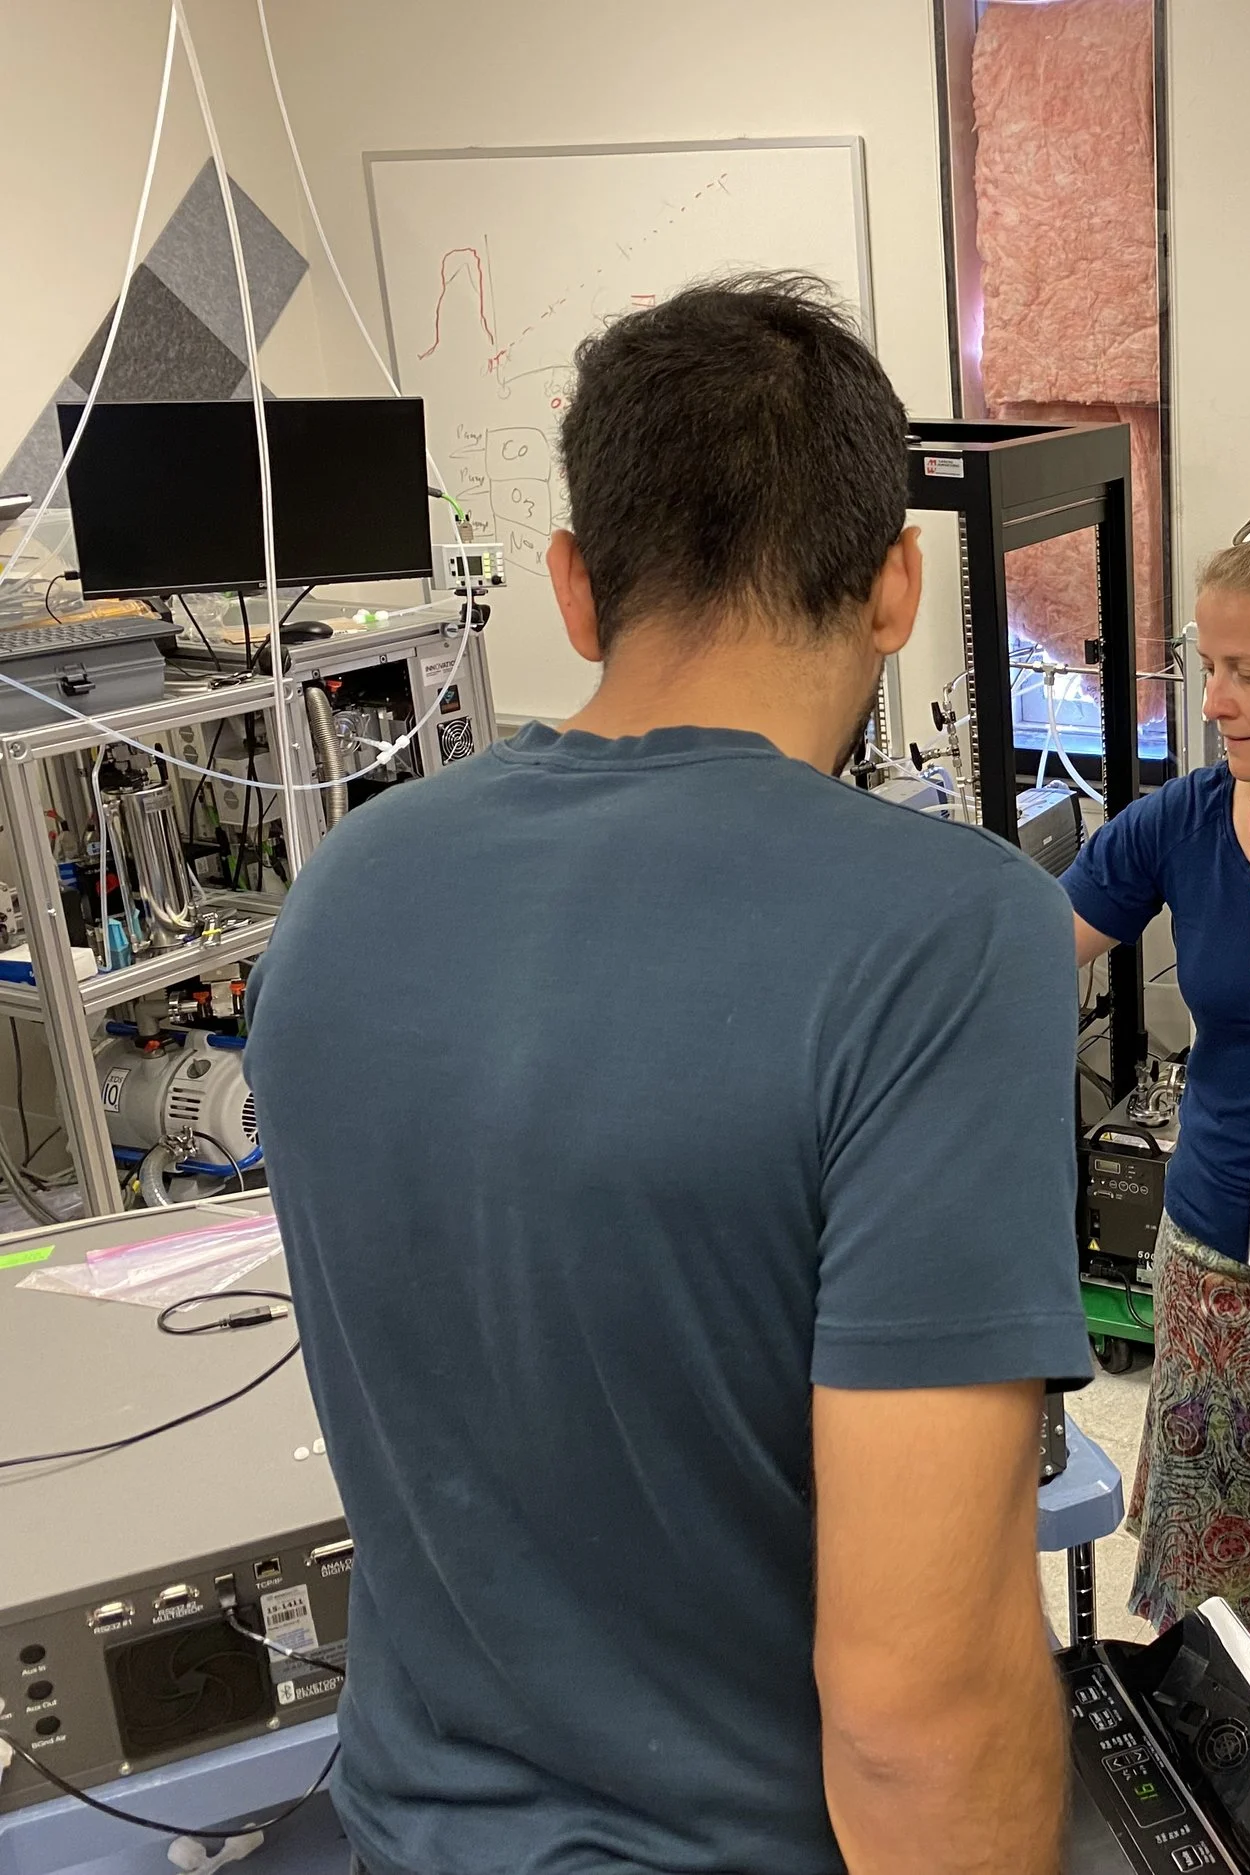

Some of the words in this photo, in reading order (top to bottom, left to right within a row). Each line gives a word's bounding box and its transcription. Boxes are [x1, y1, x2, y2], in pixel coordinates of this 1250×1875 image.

[103, 1083, 118, 1106] 10
[152, 1605, 204, 1625] MULTIDROP
[93, 1621, 124, 1634] RS232
[21, 1667, 38, 1676] Aux
[25, 1703, 43, 1713] Aux
